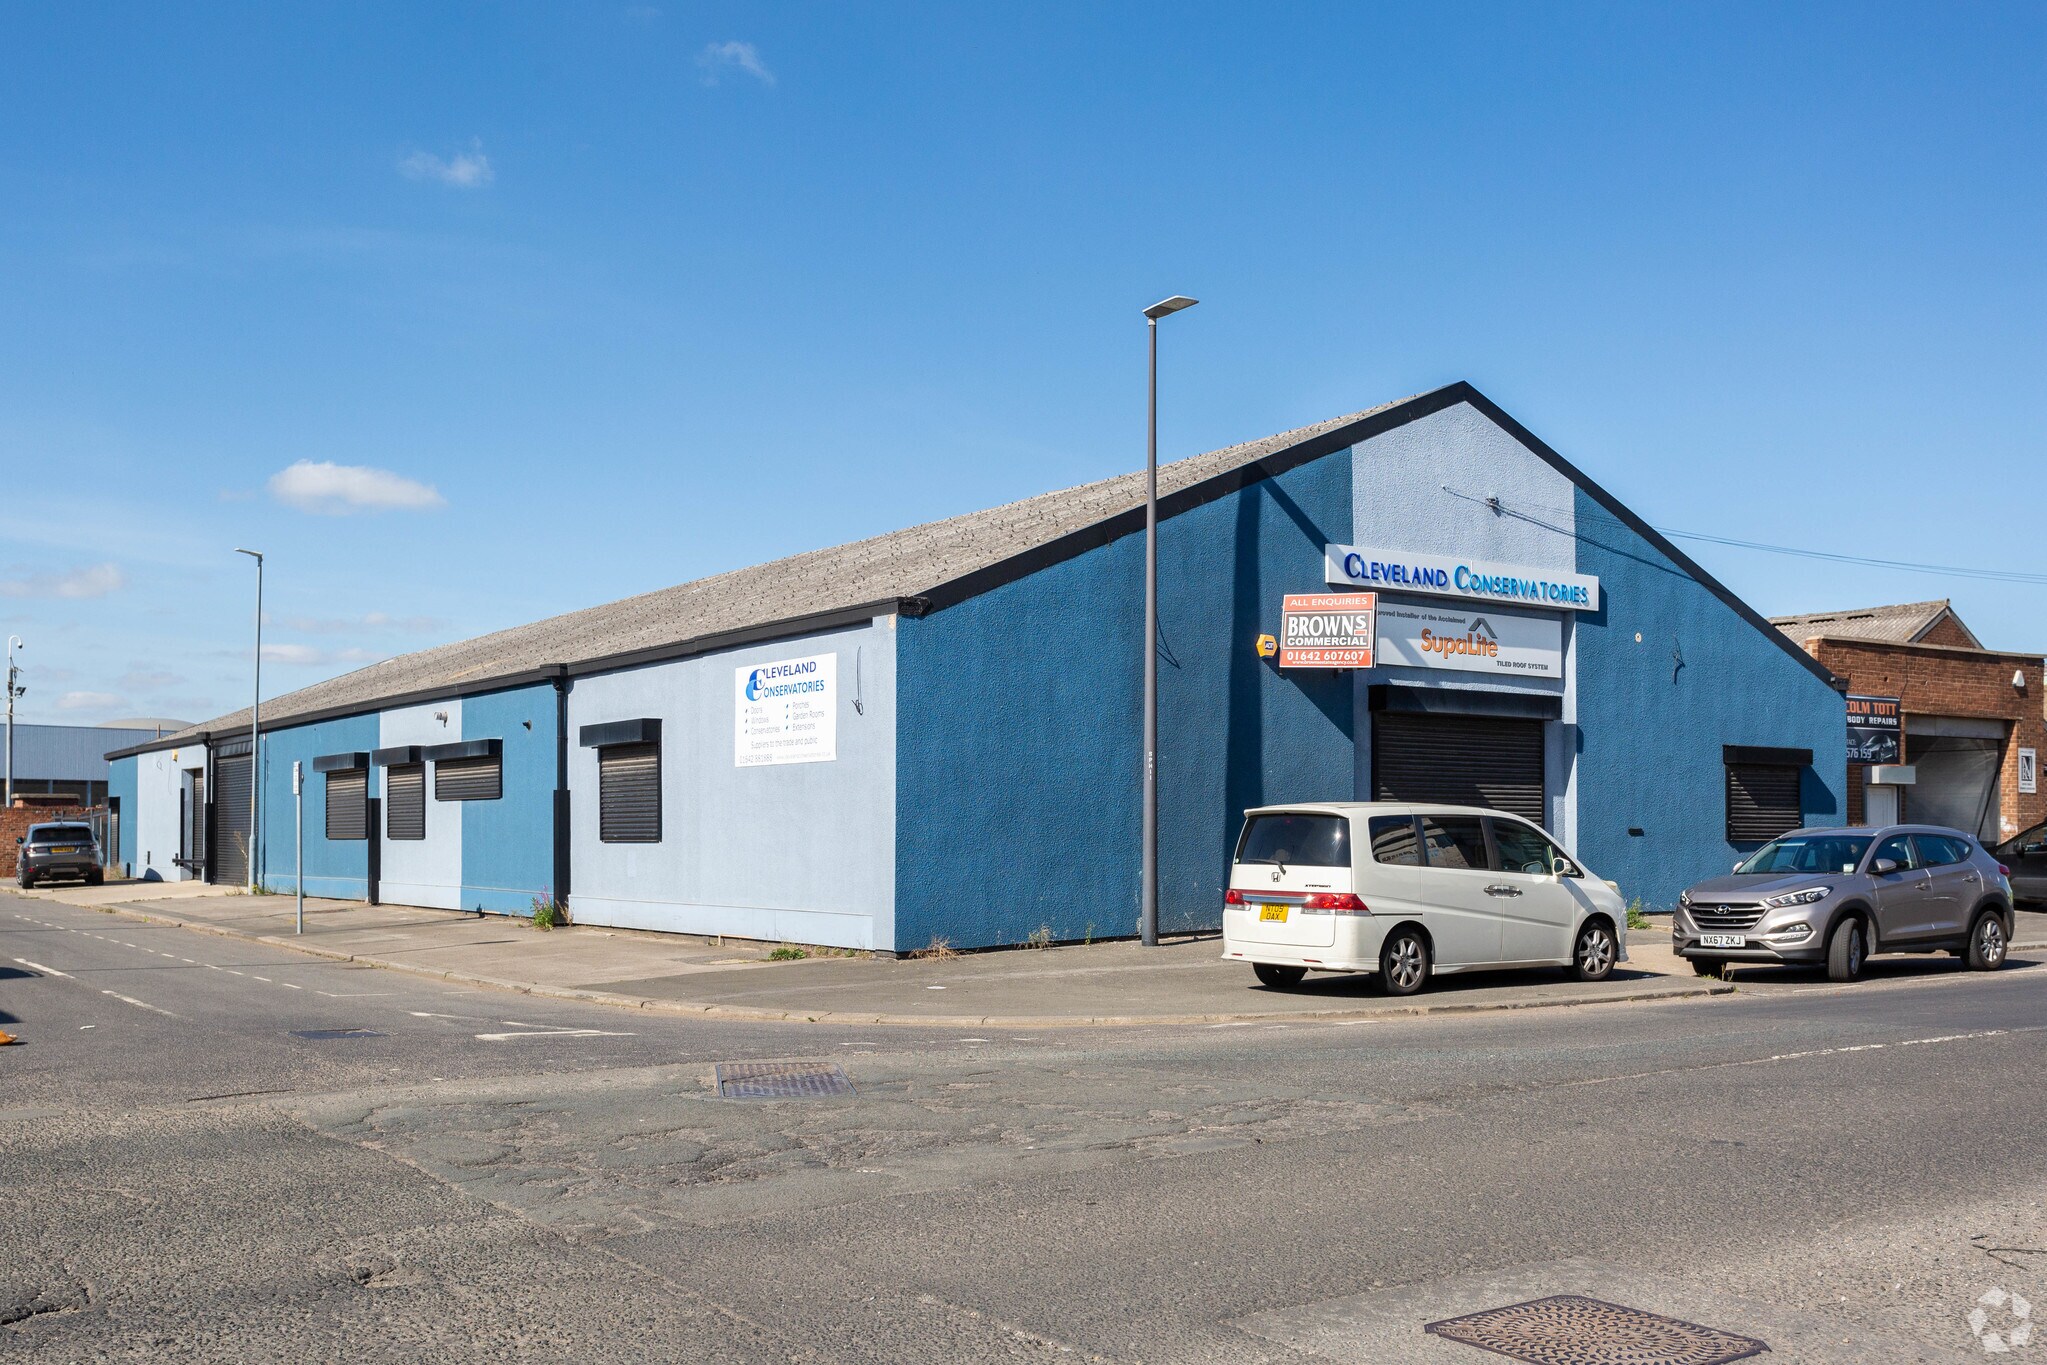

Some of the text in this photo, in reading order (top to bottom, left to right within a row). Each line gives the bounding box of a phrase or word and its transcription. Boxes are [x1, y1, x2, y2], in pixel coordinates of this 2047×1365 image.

[1344, 553, 1588, 603] CLEVELAND CONSERVATORIES
[1290, 597, 1368, 607] ALL ENQUIRIES
[1396, 611, 1420, 620] Installer
[1437, 615, 1466, 624] Acclaimed
[1287, 615, 1367, 637] BROWNS
[1287, 637, 1367, 646] COMMERCIAL
[1421, 628, 1498, 660] SupaLite
[1287, 651, 1365, 661] 01642 607607
[1496, 660, 1549, 671] TILED ROOF SYSTEM
[749, 661, 817, 690] CLEVELAND
[745, 679, 825, 701] CONSERVATORIES
[1872, 702, 1897, 715] TOTT
[1868, 716, 1898, 726] REPAIRS
[1703, 935, 1741, 945] NX67 ZKJ
